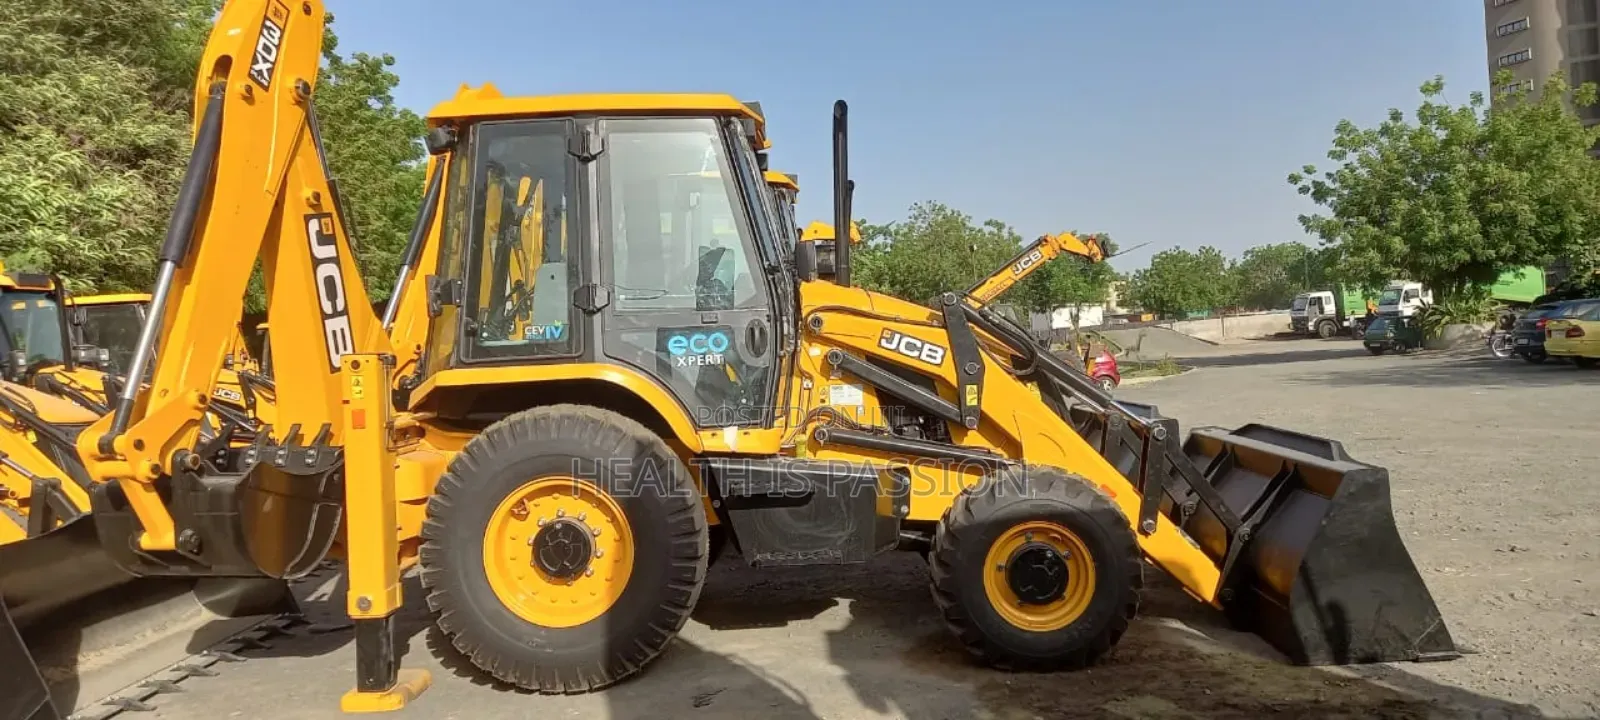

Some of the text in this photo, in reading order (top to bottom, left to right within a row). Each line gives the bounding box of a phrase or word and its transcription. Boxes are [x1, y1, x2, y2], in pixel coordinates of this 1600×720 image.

[1013, 250, 1042, 275] JCB
[308, 218, 353, 368] JCB
[668, 332, 728, 355] eco
[880, 332, 945, 365] JCB
[676, 354, 725, 367] XPERT
[213, 388, 241, 401] JCB
